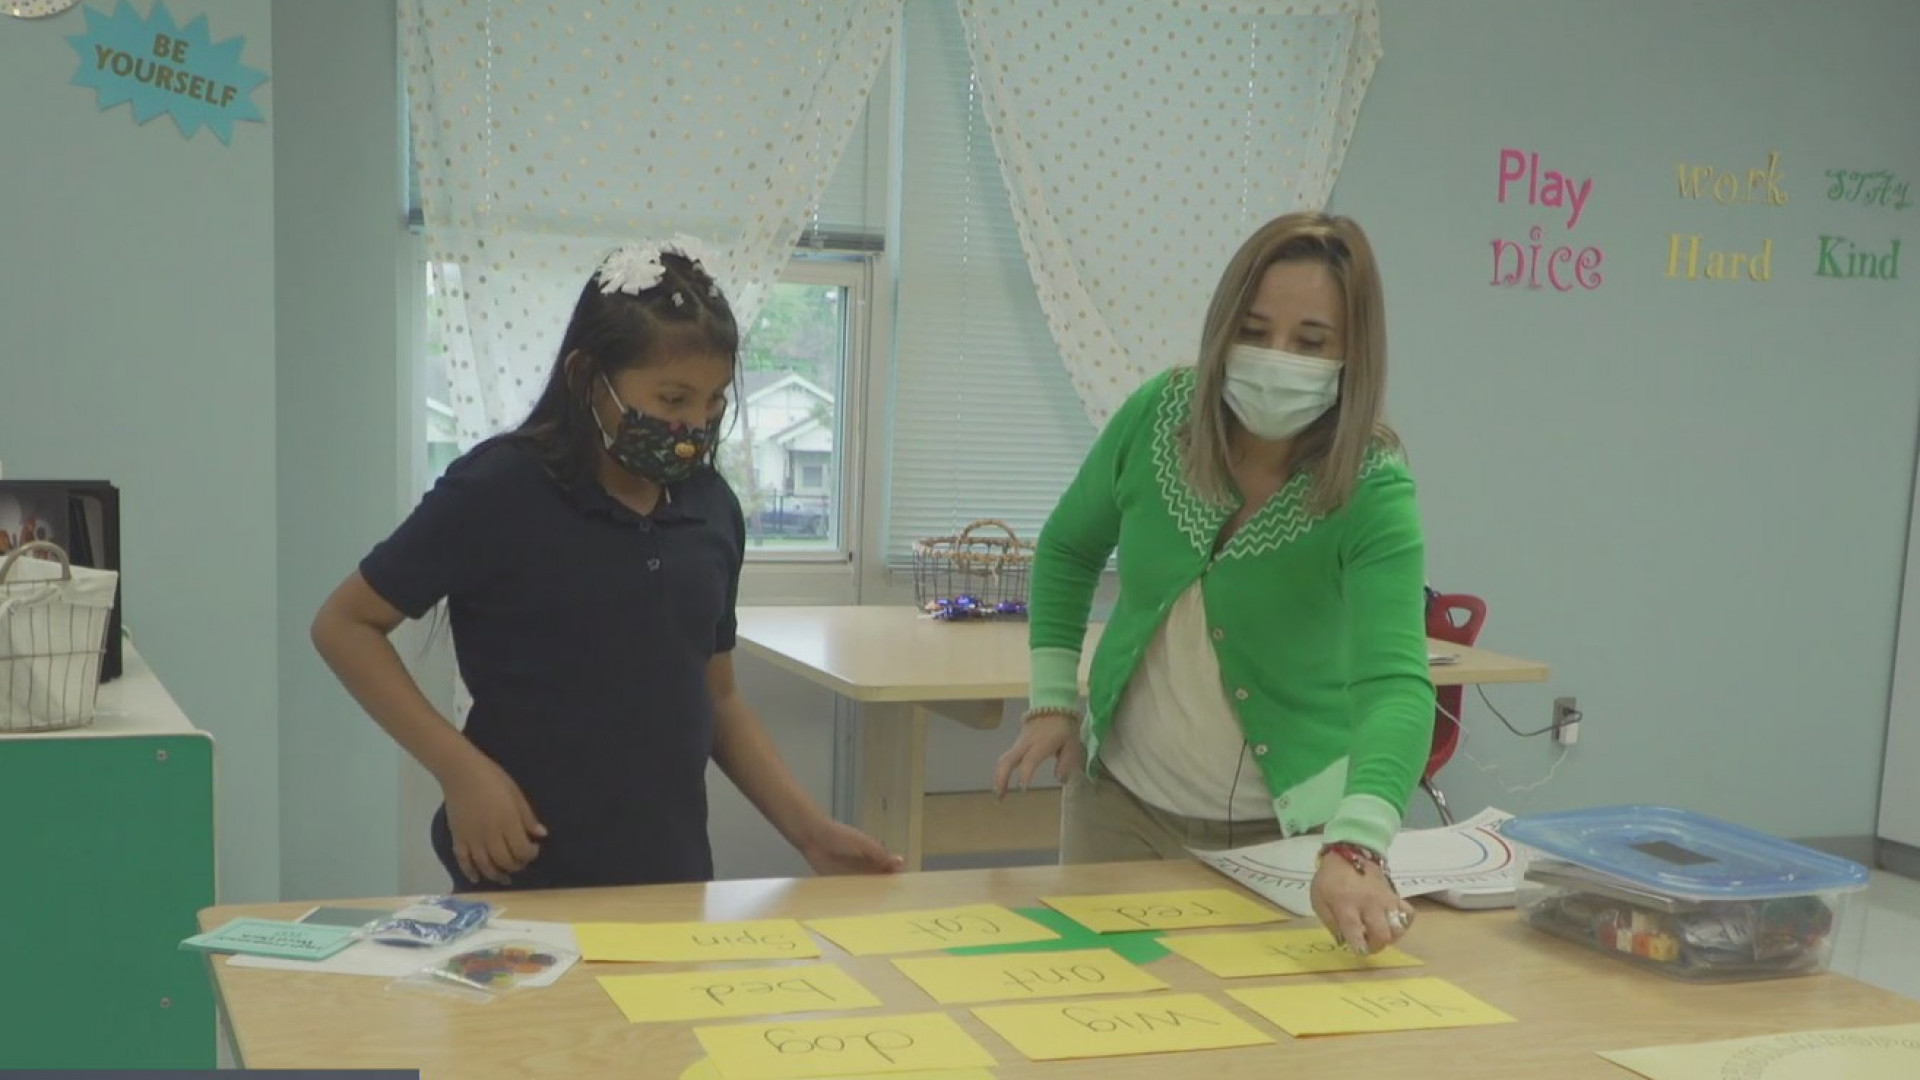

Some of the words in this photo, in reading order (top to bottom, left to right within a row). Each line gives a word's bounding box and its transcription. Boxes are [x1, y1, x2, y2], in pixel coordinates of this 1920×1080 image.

[153, 33, 190, 64] BE
[94, 44, 238, 108] YOURSELF
[1498, 148, 1594, 229] Play
[1664, 233, 1773, 282] Hard
[1815, 234, 1900, 281] Kind
[763, 1027, 914, 1065] dog
